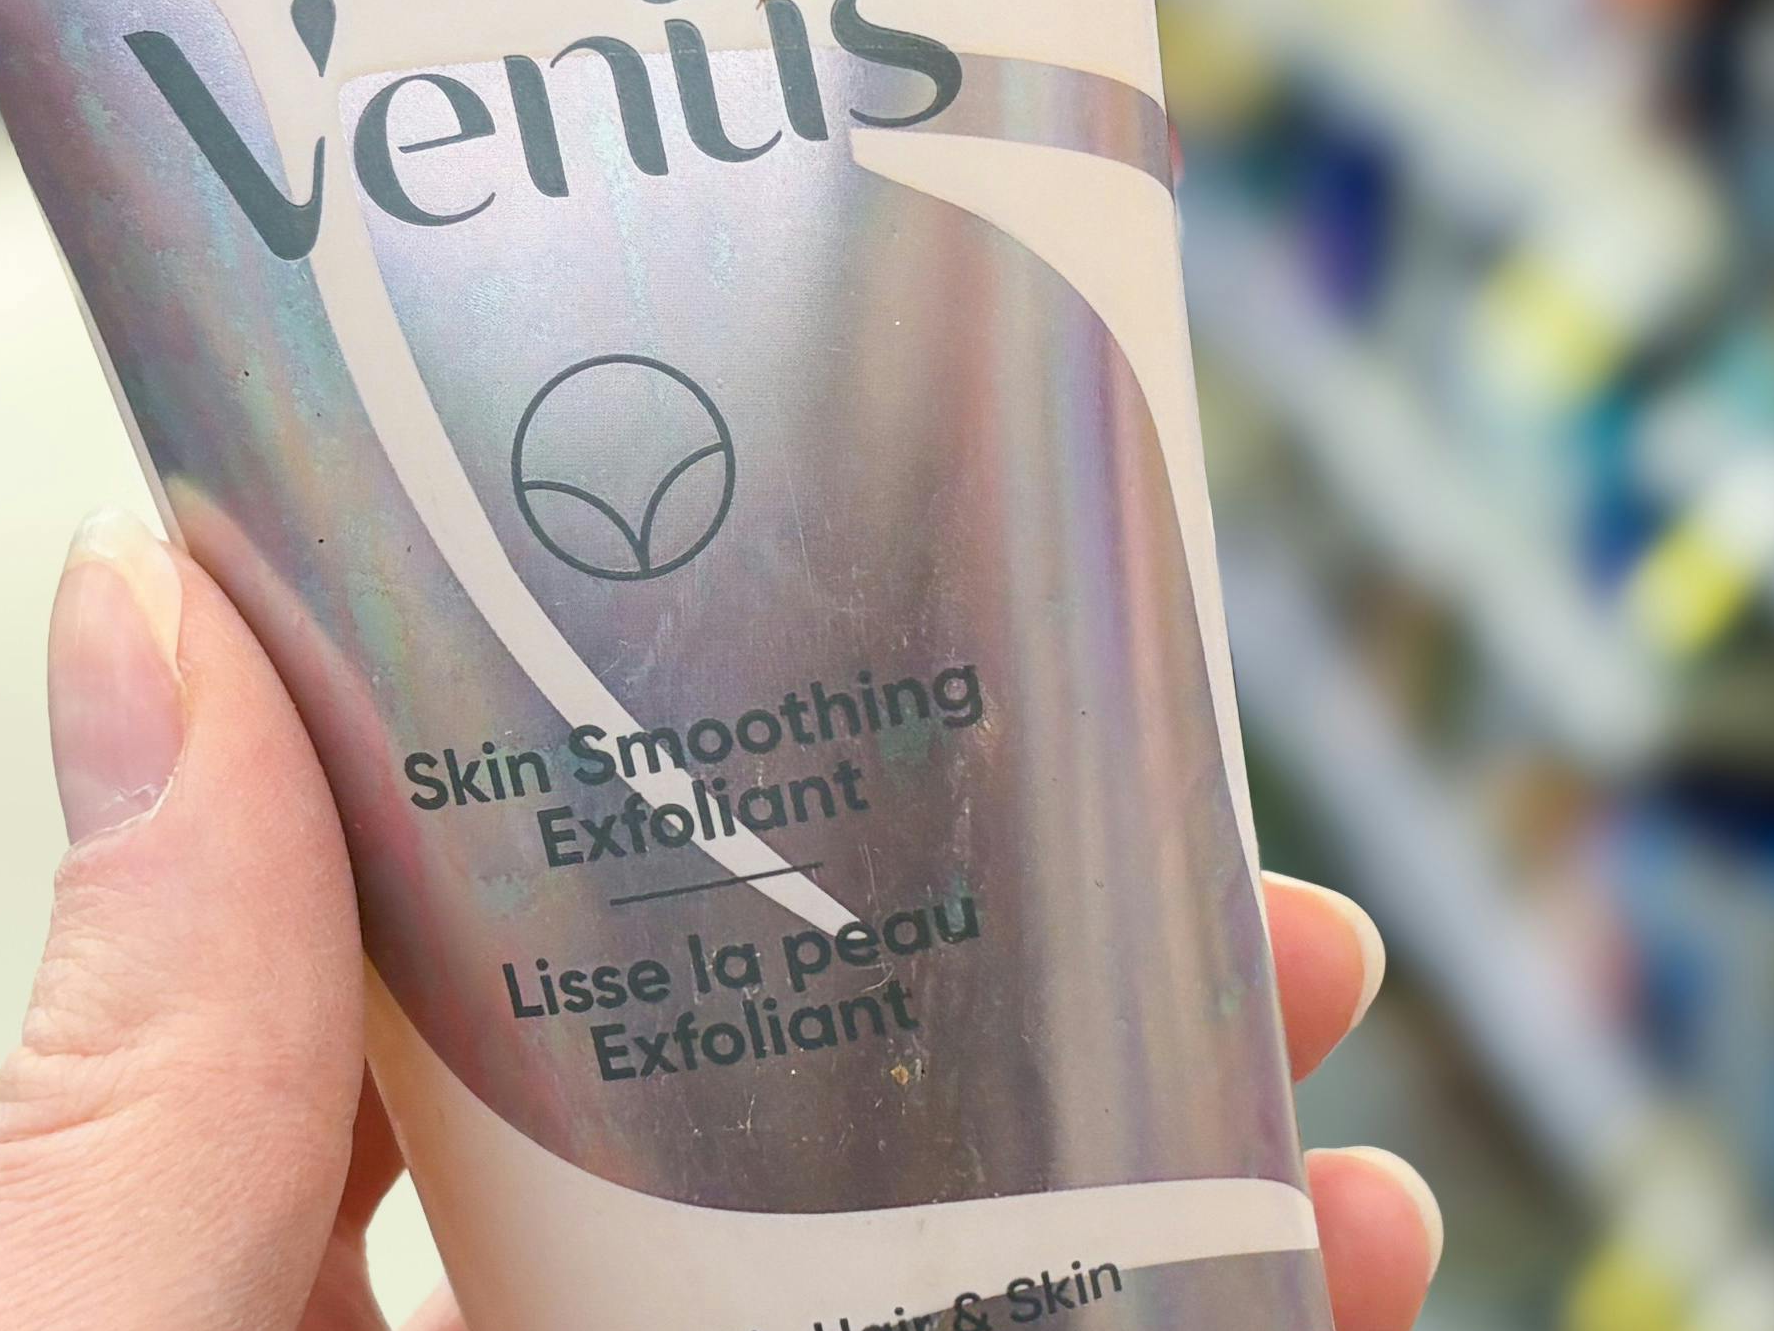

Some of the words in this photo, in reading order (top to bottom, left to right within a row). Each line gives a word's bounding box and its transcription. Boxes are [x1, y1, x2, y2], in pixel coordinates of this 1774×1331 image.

[403, 741, 551, 811] Skin
[568, 664, 985, 785] Smoothing
[537, 760, 869, 868] Exfoliant
[502, 951, 671, 1020] Lisse
[687, 933, 762, 993] la
[783, 894, 980, 992] peau
[591, 980, 920, 1082] Exfoliant
[1007, 1258, 1123, 1323] Skin
